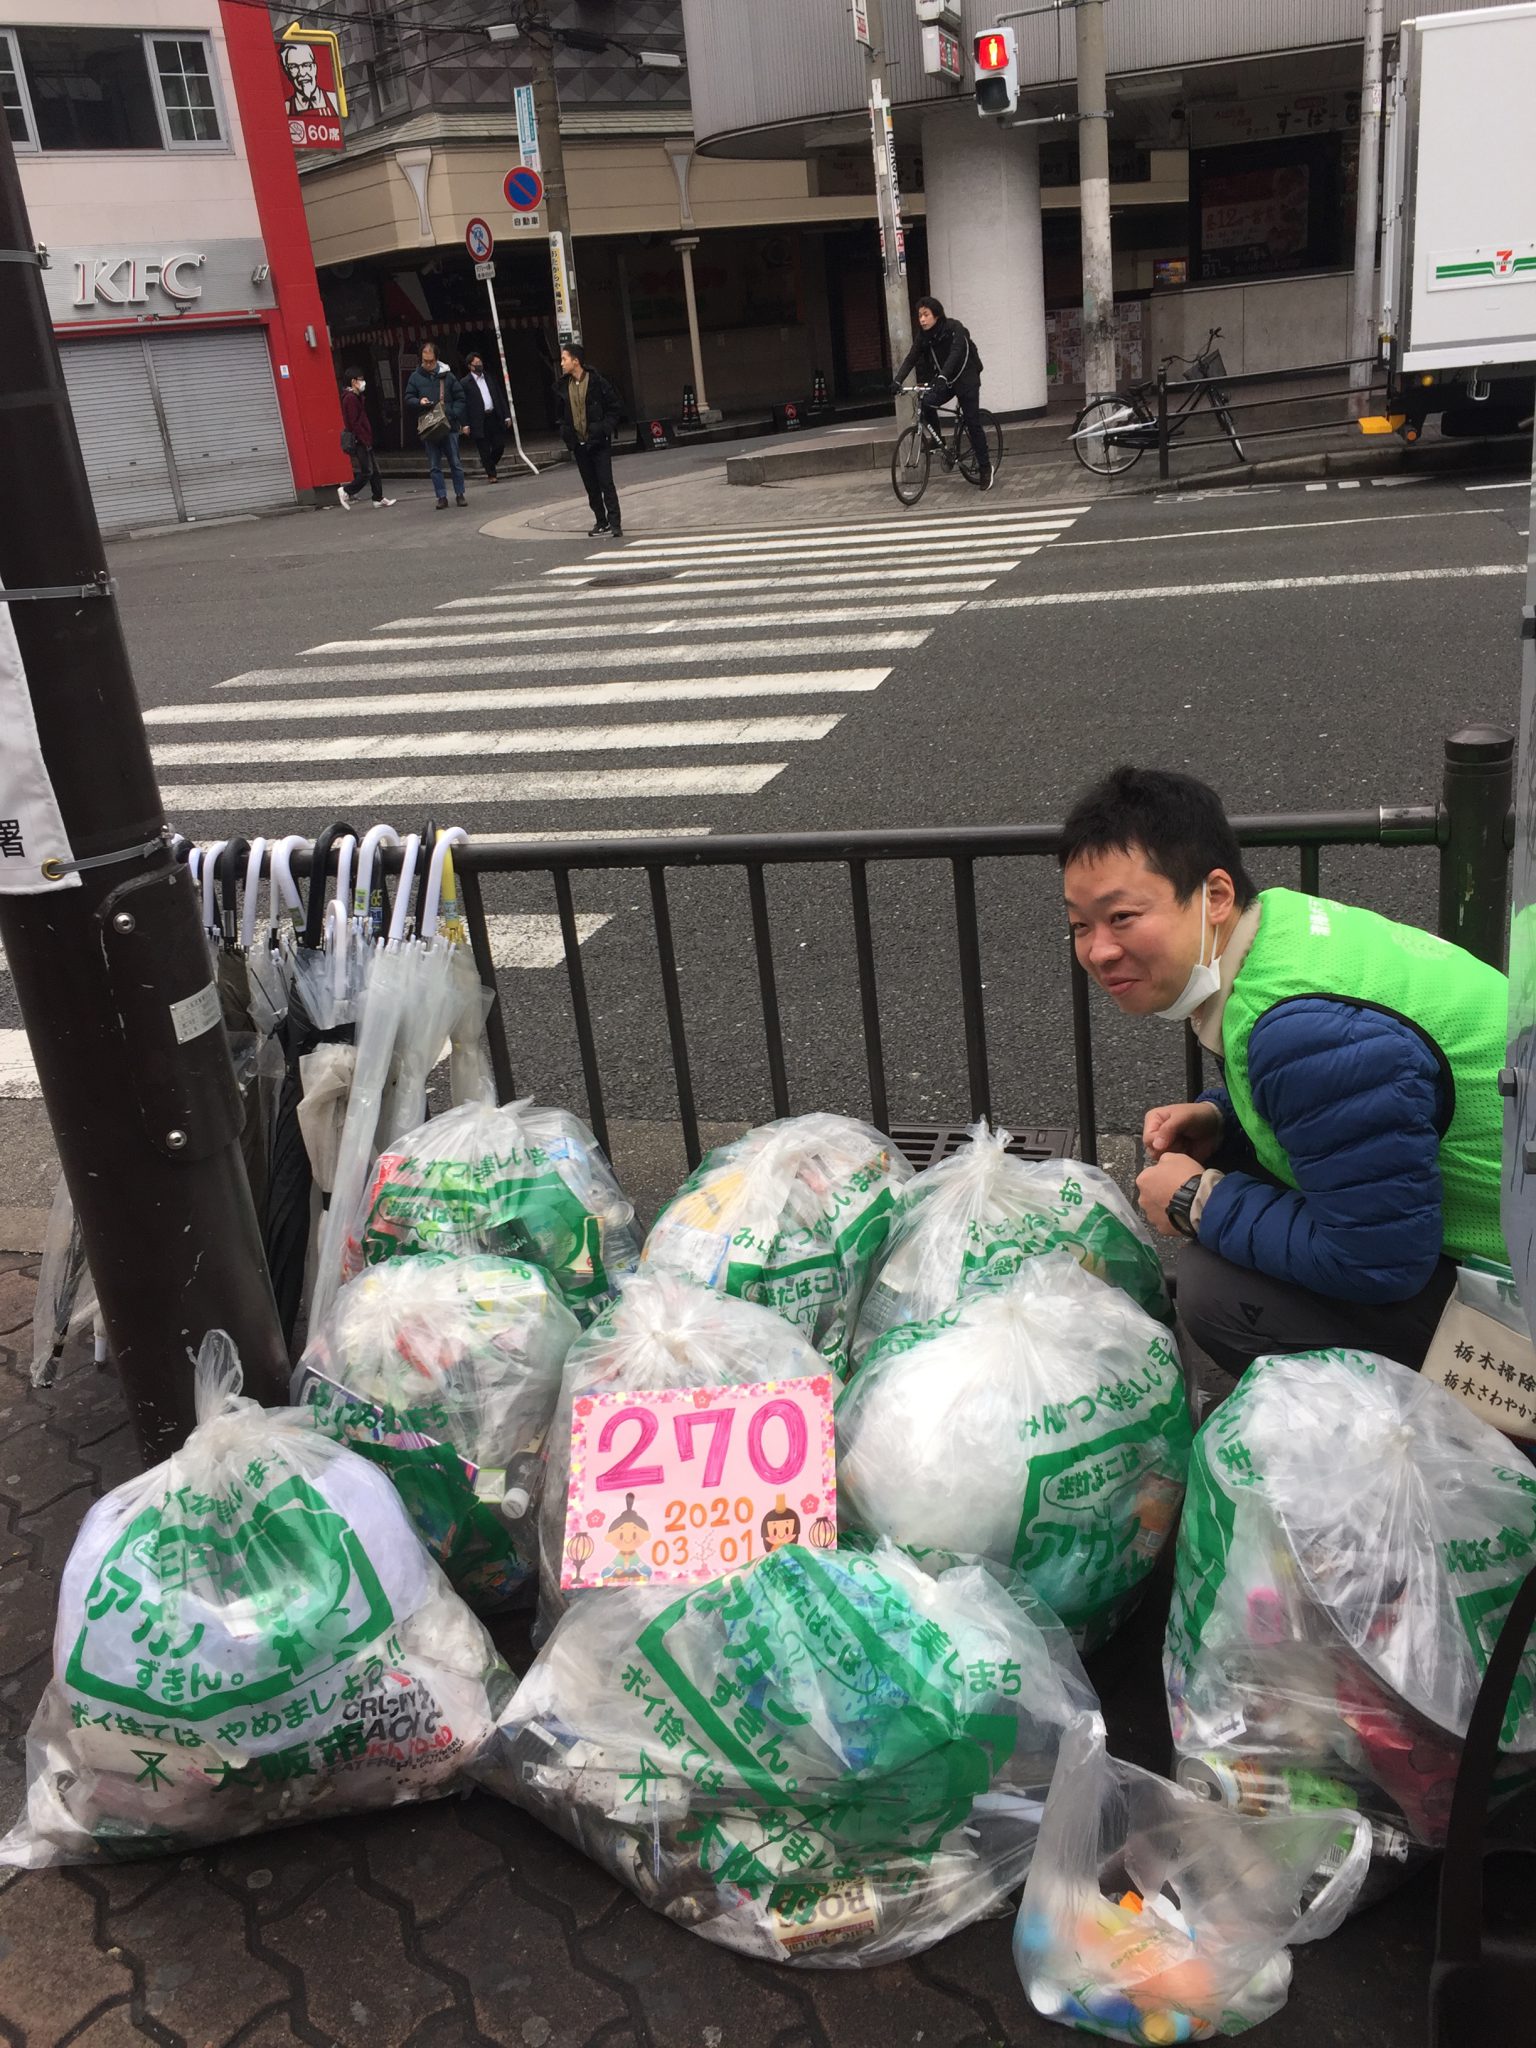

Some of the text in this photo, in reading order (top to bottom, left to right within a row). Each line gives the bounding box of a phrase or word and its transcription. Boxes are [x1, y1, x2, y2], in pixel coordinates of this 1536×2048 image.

[73, 254, 202, 306] KFC
[596, 1397, 808, 1492] 270
[664, 1496, 754, 1533] 2020
[651, 1528, 754, 1567] 03 01
[135, 1657, 245, 1702] ずきん。
[70, 1701, 206, 1749] ポイ捨ては
[621, 1663, 726, 1798] ポイ捨ては
